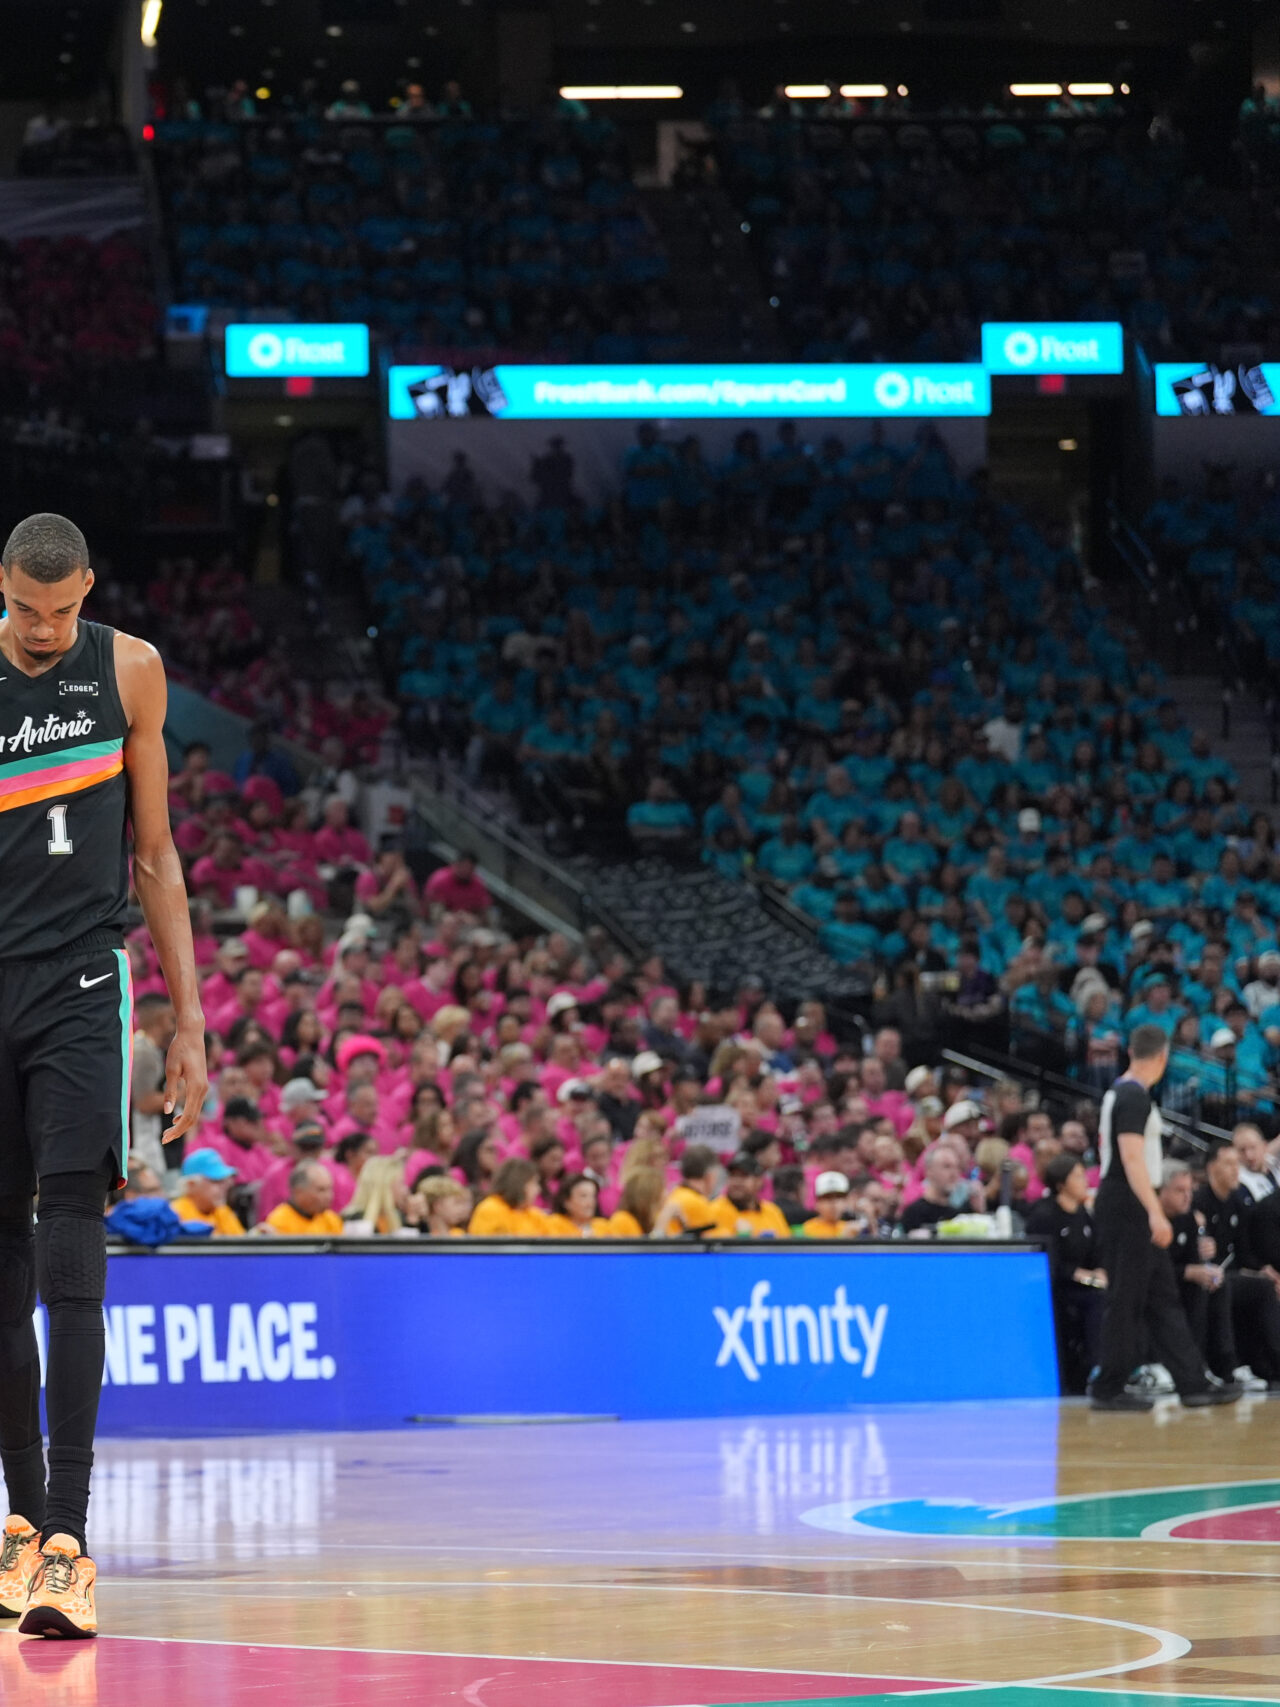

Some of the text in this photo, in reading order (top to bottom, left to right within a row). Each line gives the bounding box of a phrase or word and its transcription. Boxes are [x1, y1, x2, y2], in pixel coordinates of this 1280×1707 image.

[283, 336, 345, 364] Frost
[1040, 335, 1100, 362] Frost
[912, 376, 976, 404] Frost
[63, 684, 94, 693] LEDGER
[7, 709, 97, 753] Antonio
[46, 804, 74, 855] 1
[101, 1304, 159, 1386] NE
[163, 1302, 336, 1384] PLACE.
[712, 1280, 888, 1381] xfinity
